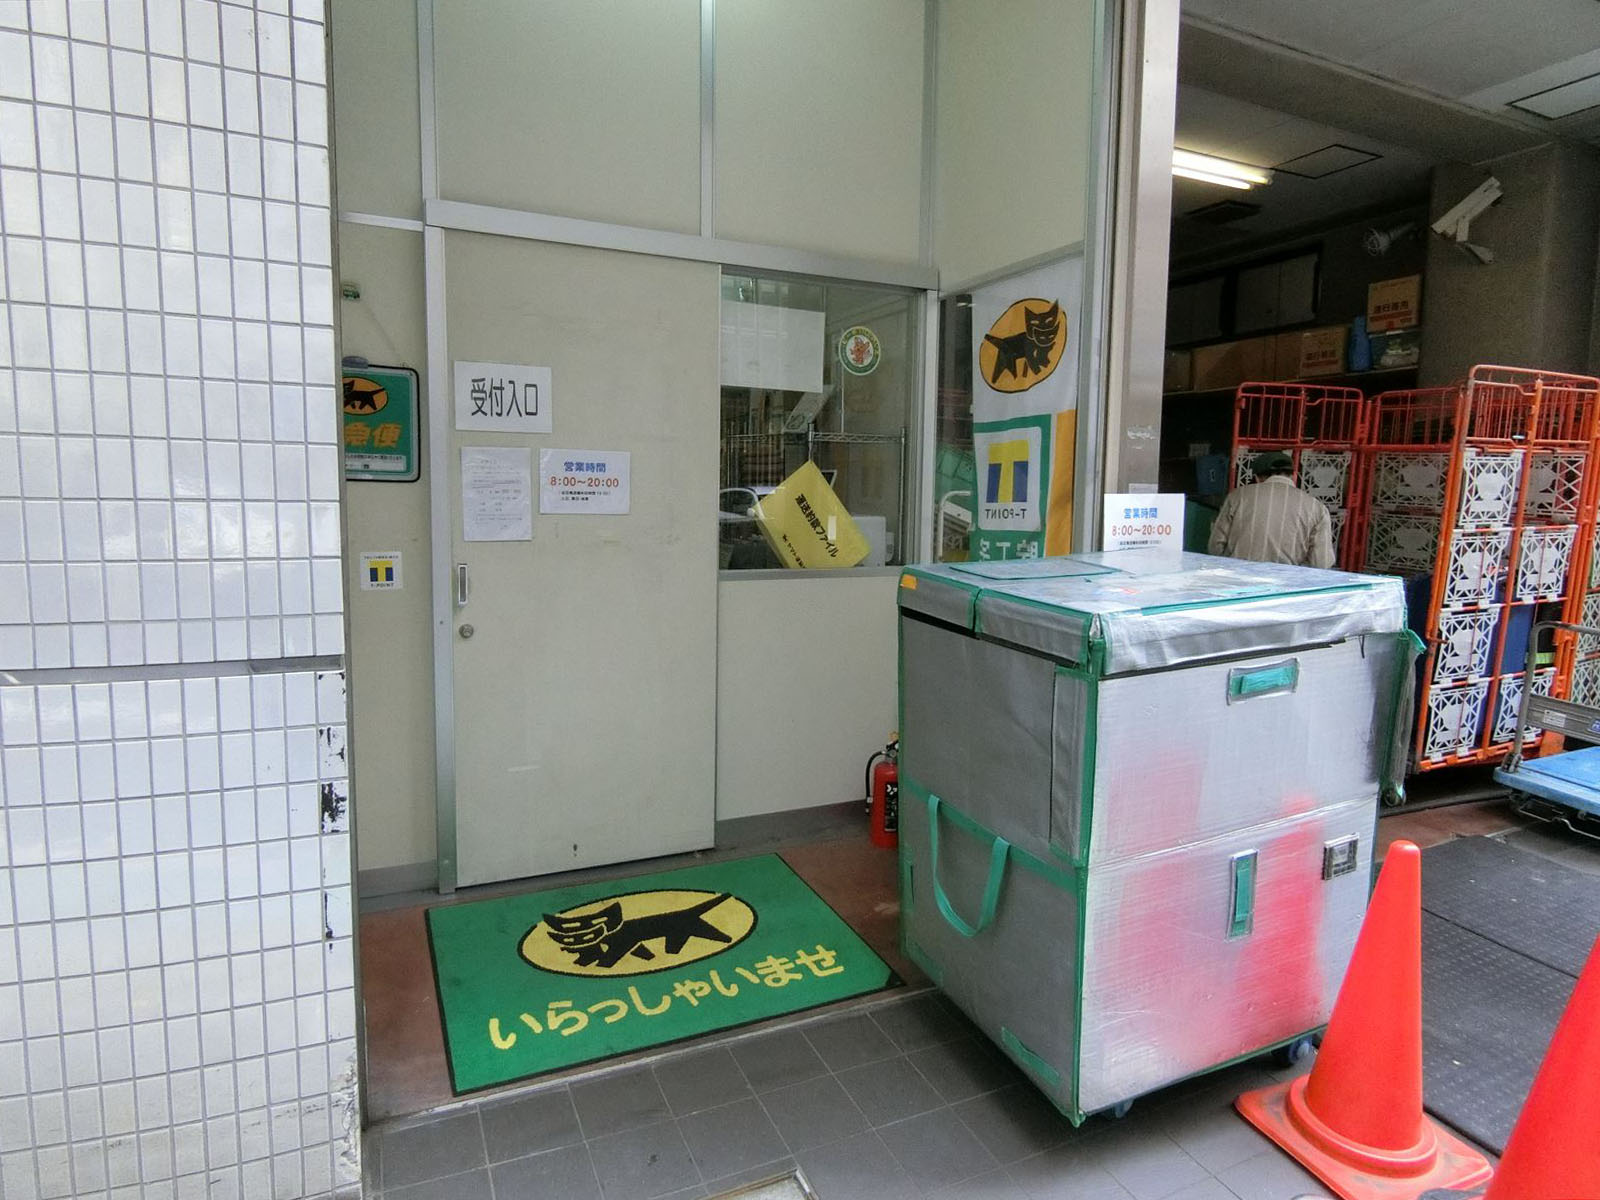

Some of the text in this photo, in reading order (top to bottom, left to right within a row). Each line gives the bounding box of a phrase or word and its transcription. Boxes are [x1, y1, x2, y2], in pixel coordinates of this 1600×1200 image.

[470, 377, 539, 417] 受付入口
[563, 460, 607, 473] 営業時間
[1123, 507, 1158, 519] 営業時間
[488, 944, 844, 1051] いらっしゃいませ
